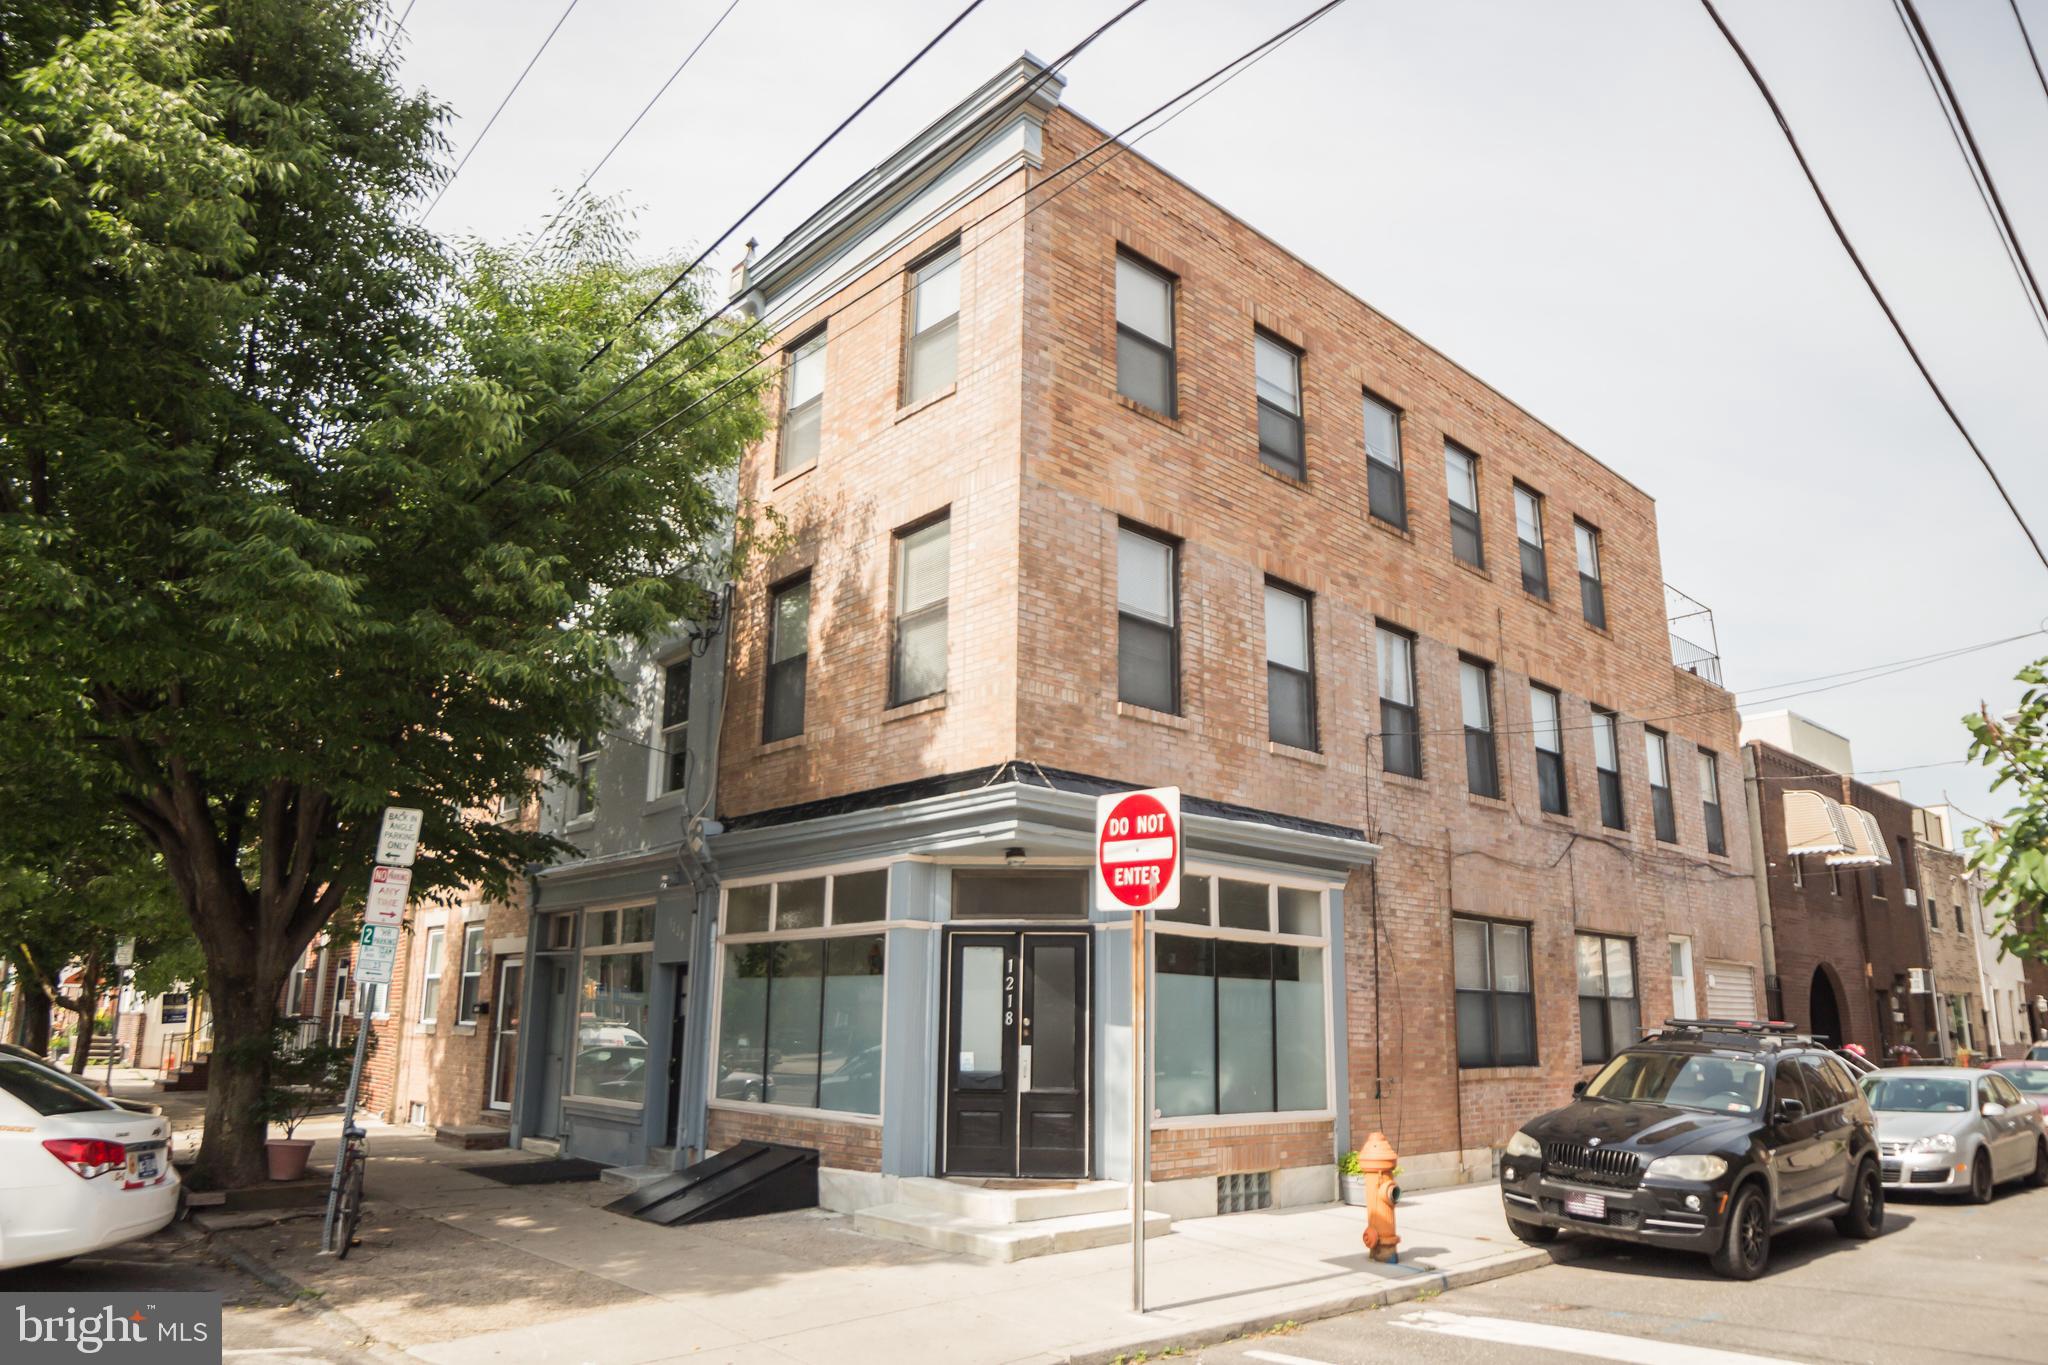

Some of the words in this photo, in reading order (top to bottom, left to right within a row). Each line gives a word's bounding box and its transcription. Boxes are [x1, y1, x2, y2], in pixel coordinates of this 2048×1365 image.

[388, 812, 408, 821] BACK
[389, 823, 414, 832] ANGLE
[1109, 817, 1129, 836] DO
[1136, 813, 1166, 834] NOT
[384, 831, 416, 841] PARKING
[387, 841, 409, 850] ONLY
[374, 869, 387, 881] NO
[1114, 865, 1160, 887] ENTER
[363, 928, 373, 943] 2
[1005, 959, 1015, 1026] 1218
